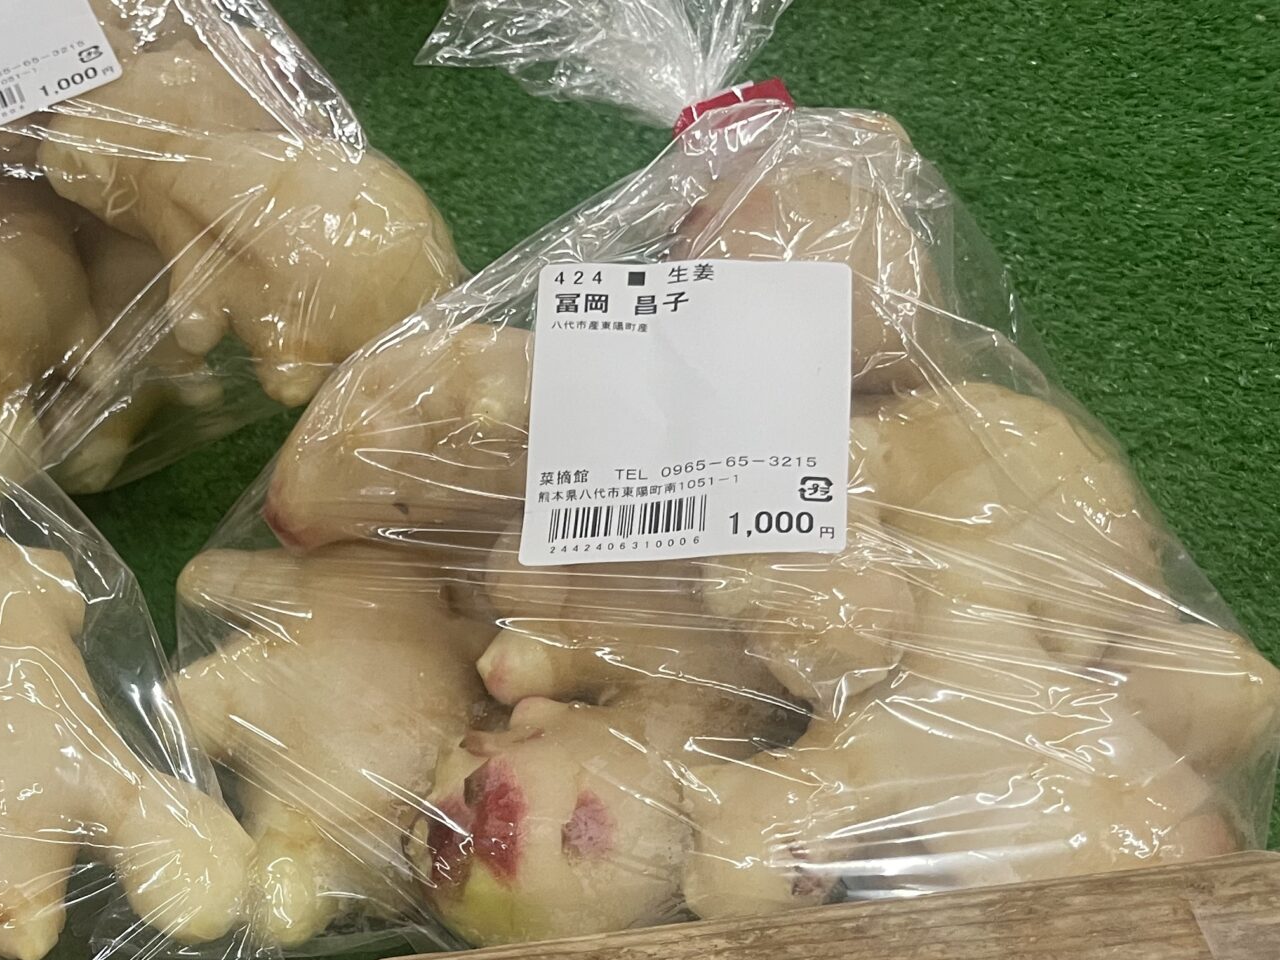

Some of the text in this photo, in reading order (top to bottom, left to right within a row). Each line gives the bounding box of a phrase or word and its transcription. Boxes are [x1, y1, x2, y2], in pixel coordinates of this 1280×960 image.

[554, 263, 715, 286] 424 生姜
[634, 291, 690, 316] 昌子
[538, 455, 818, 487] 菜摘館 TEL 0965-65-3215
